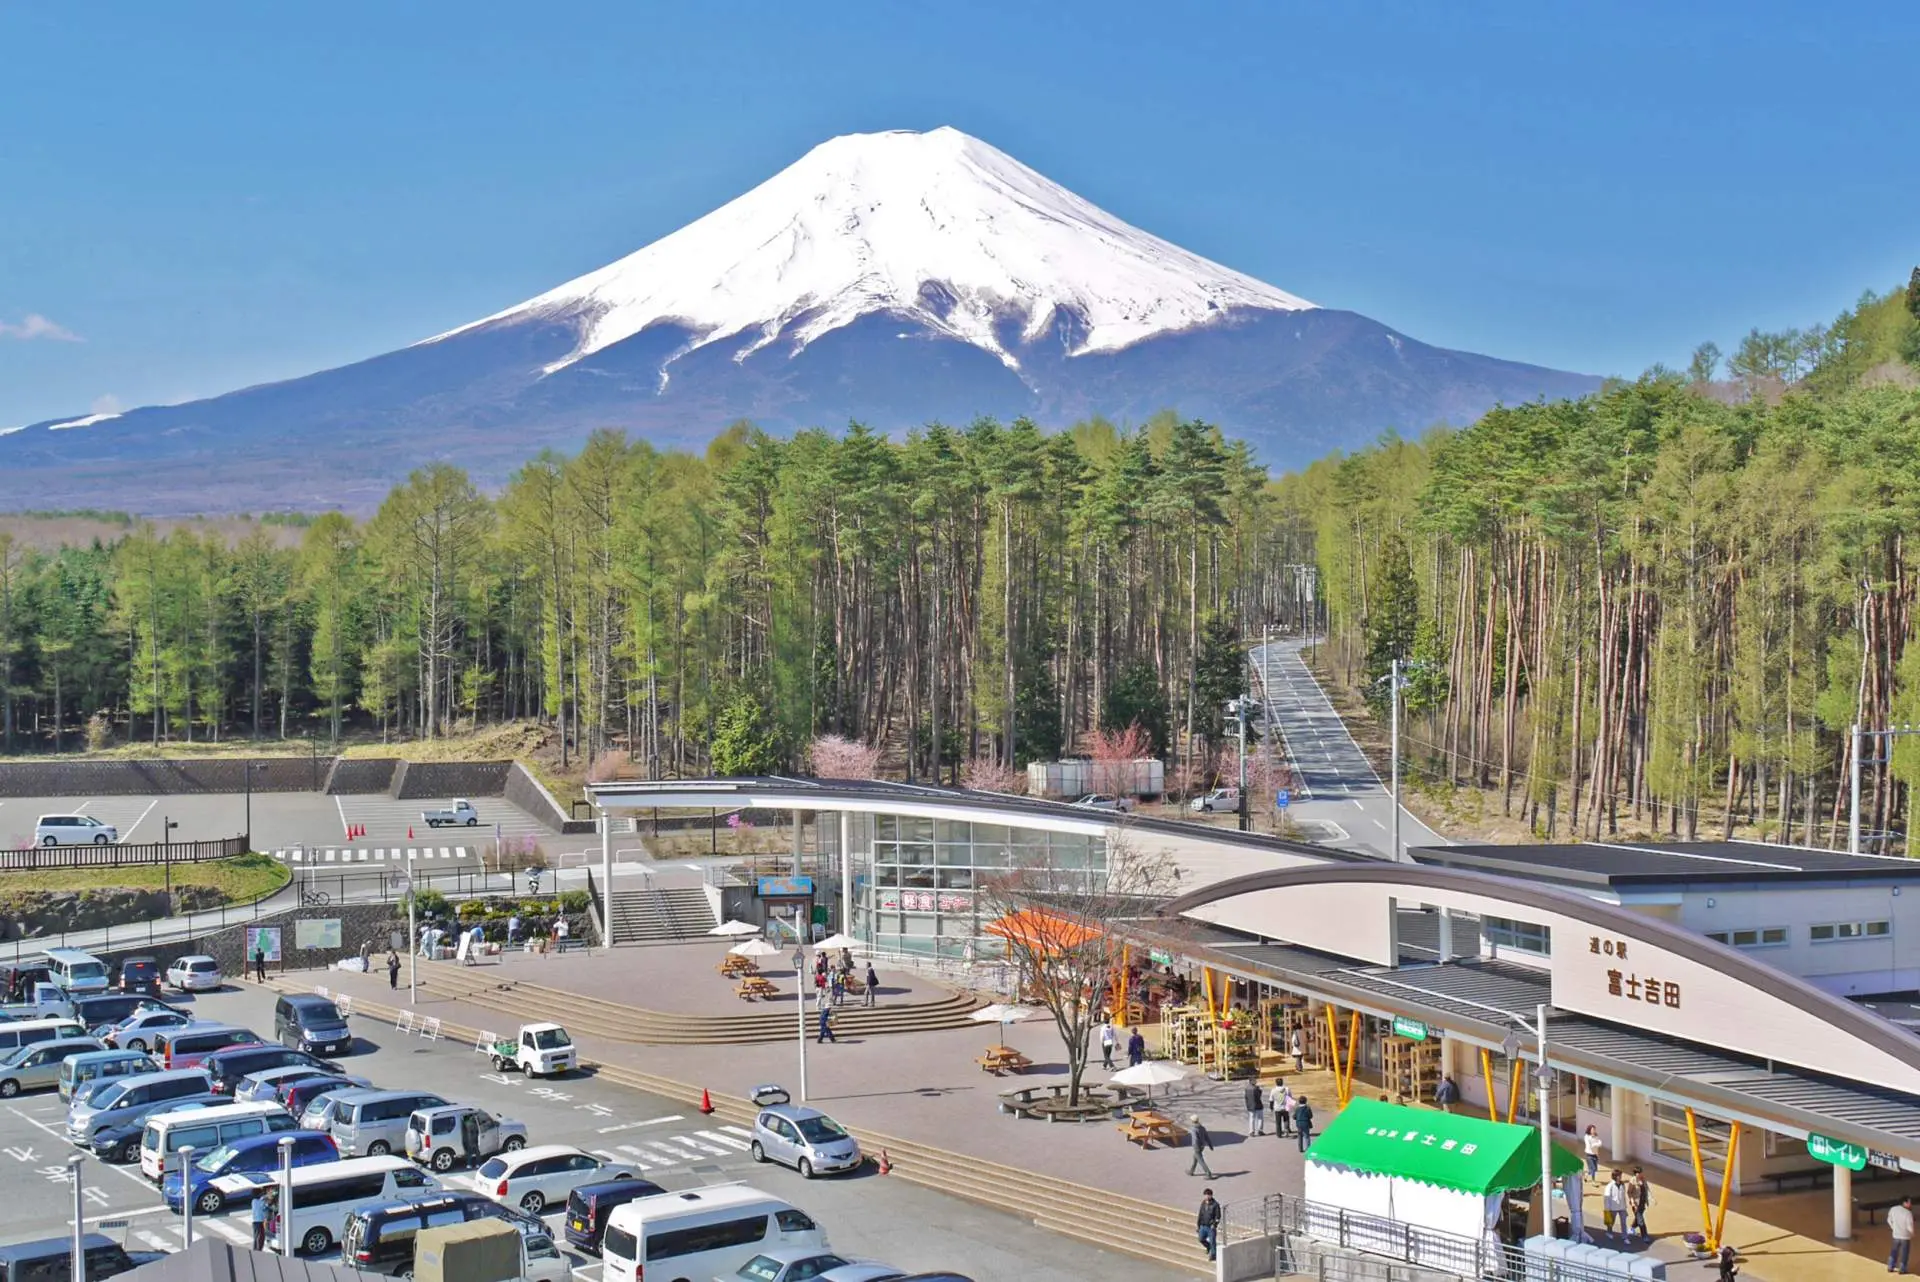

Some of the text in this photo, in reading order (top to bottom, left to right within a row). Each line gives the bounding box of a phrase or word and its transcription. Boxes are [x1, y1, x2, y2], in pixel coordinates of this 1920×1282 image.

[1589, 936, 1629, 960] 道の駅
[1607, 968, 1681, 1009] 富士吉田
[1825, 1138, 1861, 1164] トイレ
